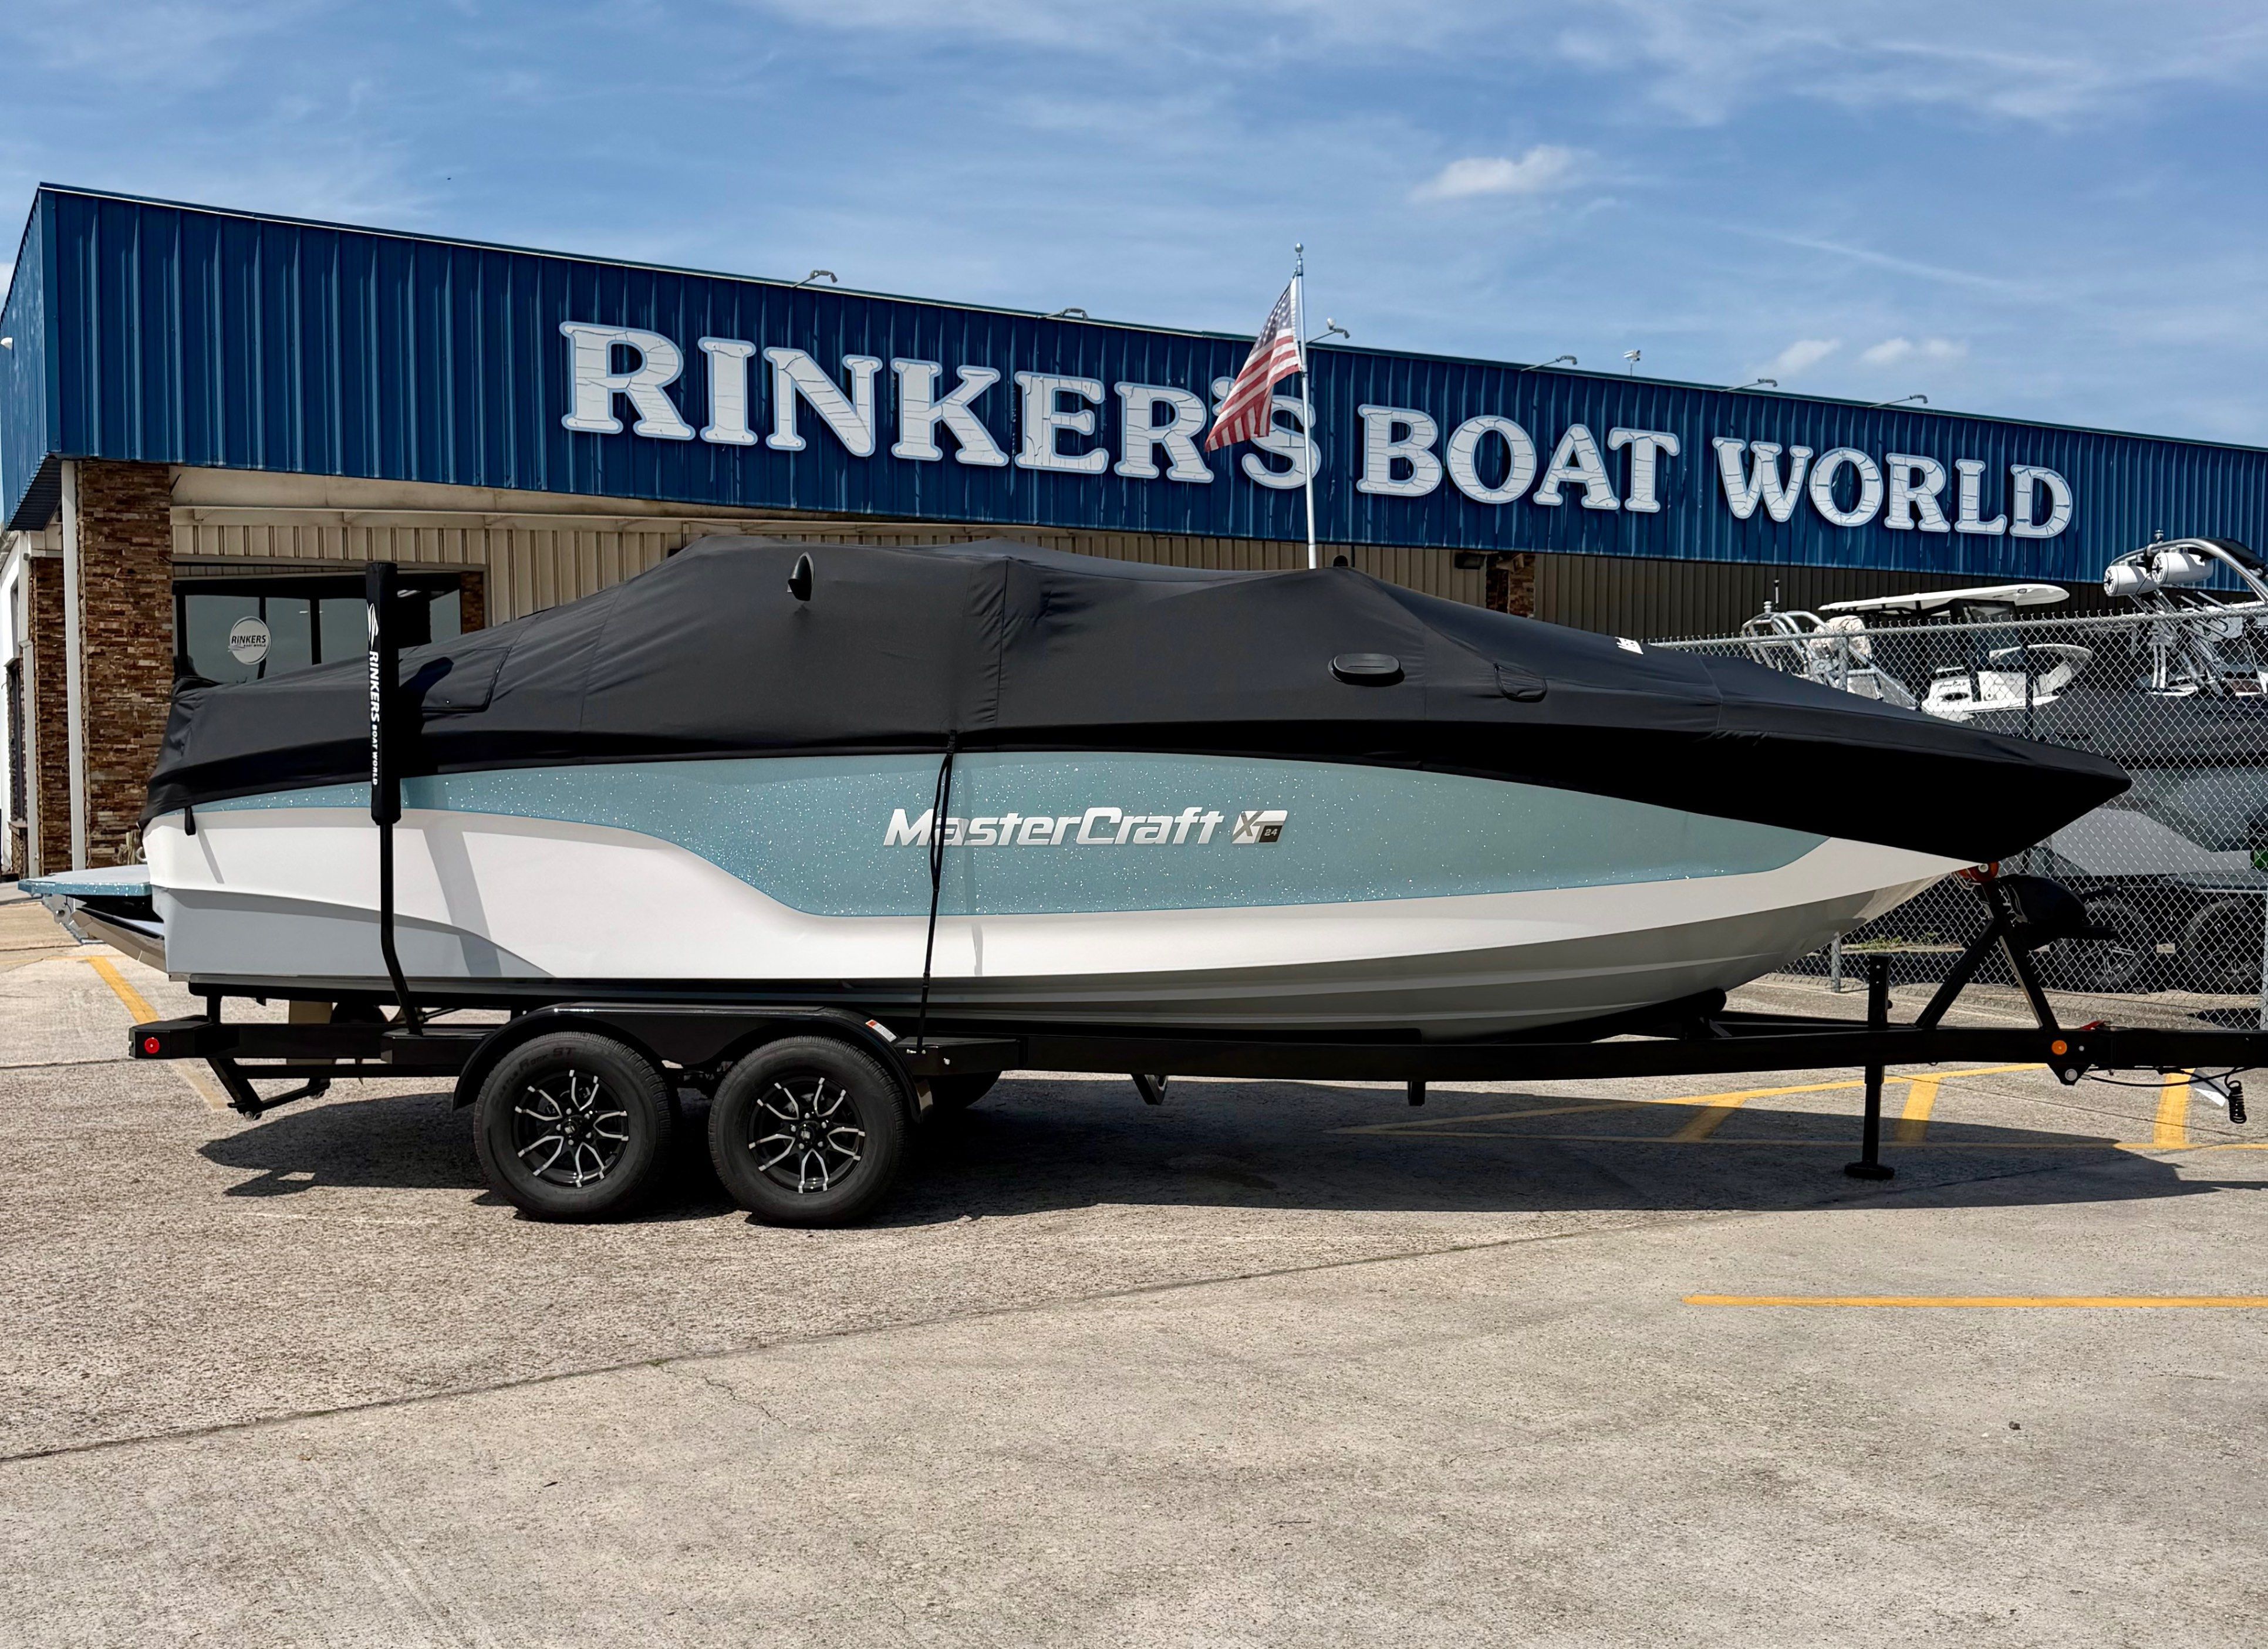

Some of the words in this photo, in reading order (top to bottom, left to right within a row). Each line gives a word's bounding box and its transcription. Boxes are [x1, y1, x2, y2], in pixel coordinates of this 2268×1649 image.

[559, 321, 1321, 489] RINKER'S
[1356, 403, 1679, 513] BOAT
[1711, 437, 2073, 539] WORLD
[231, 635, 266, 644] RINKERS
[369, 651, 380, 723] RINKERS
[883, 807, 1225, 846] MasterCraft
[1264, 828, 1278, 836] 24
